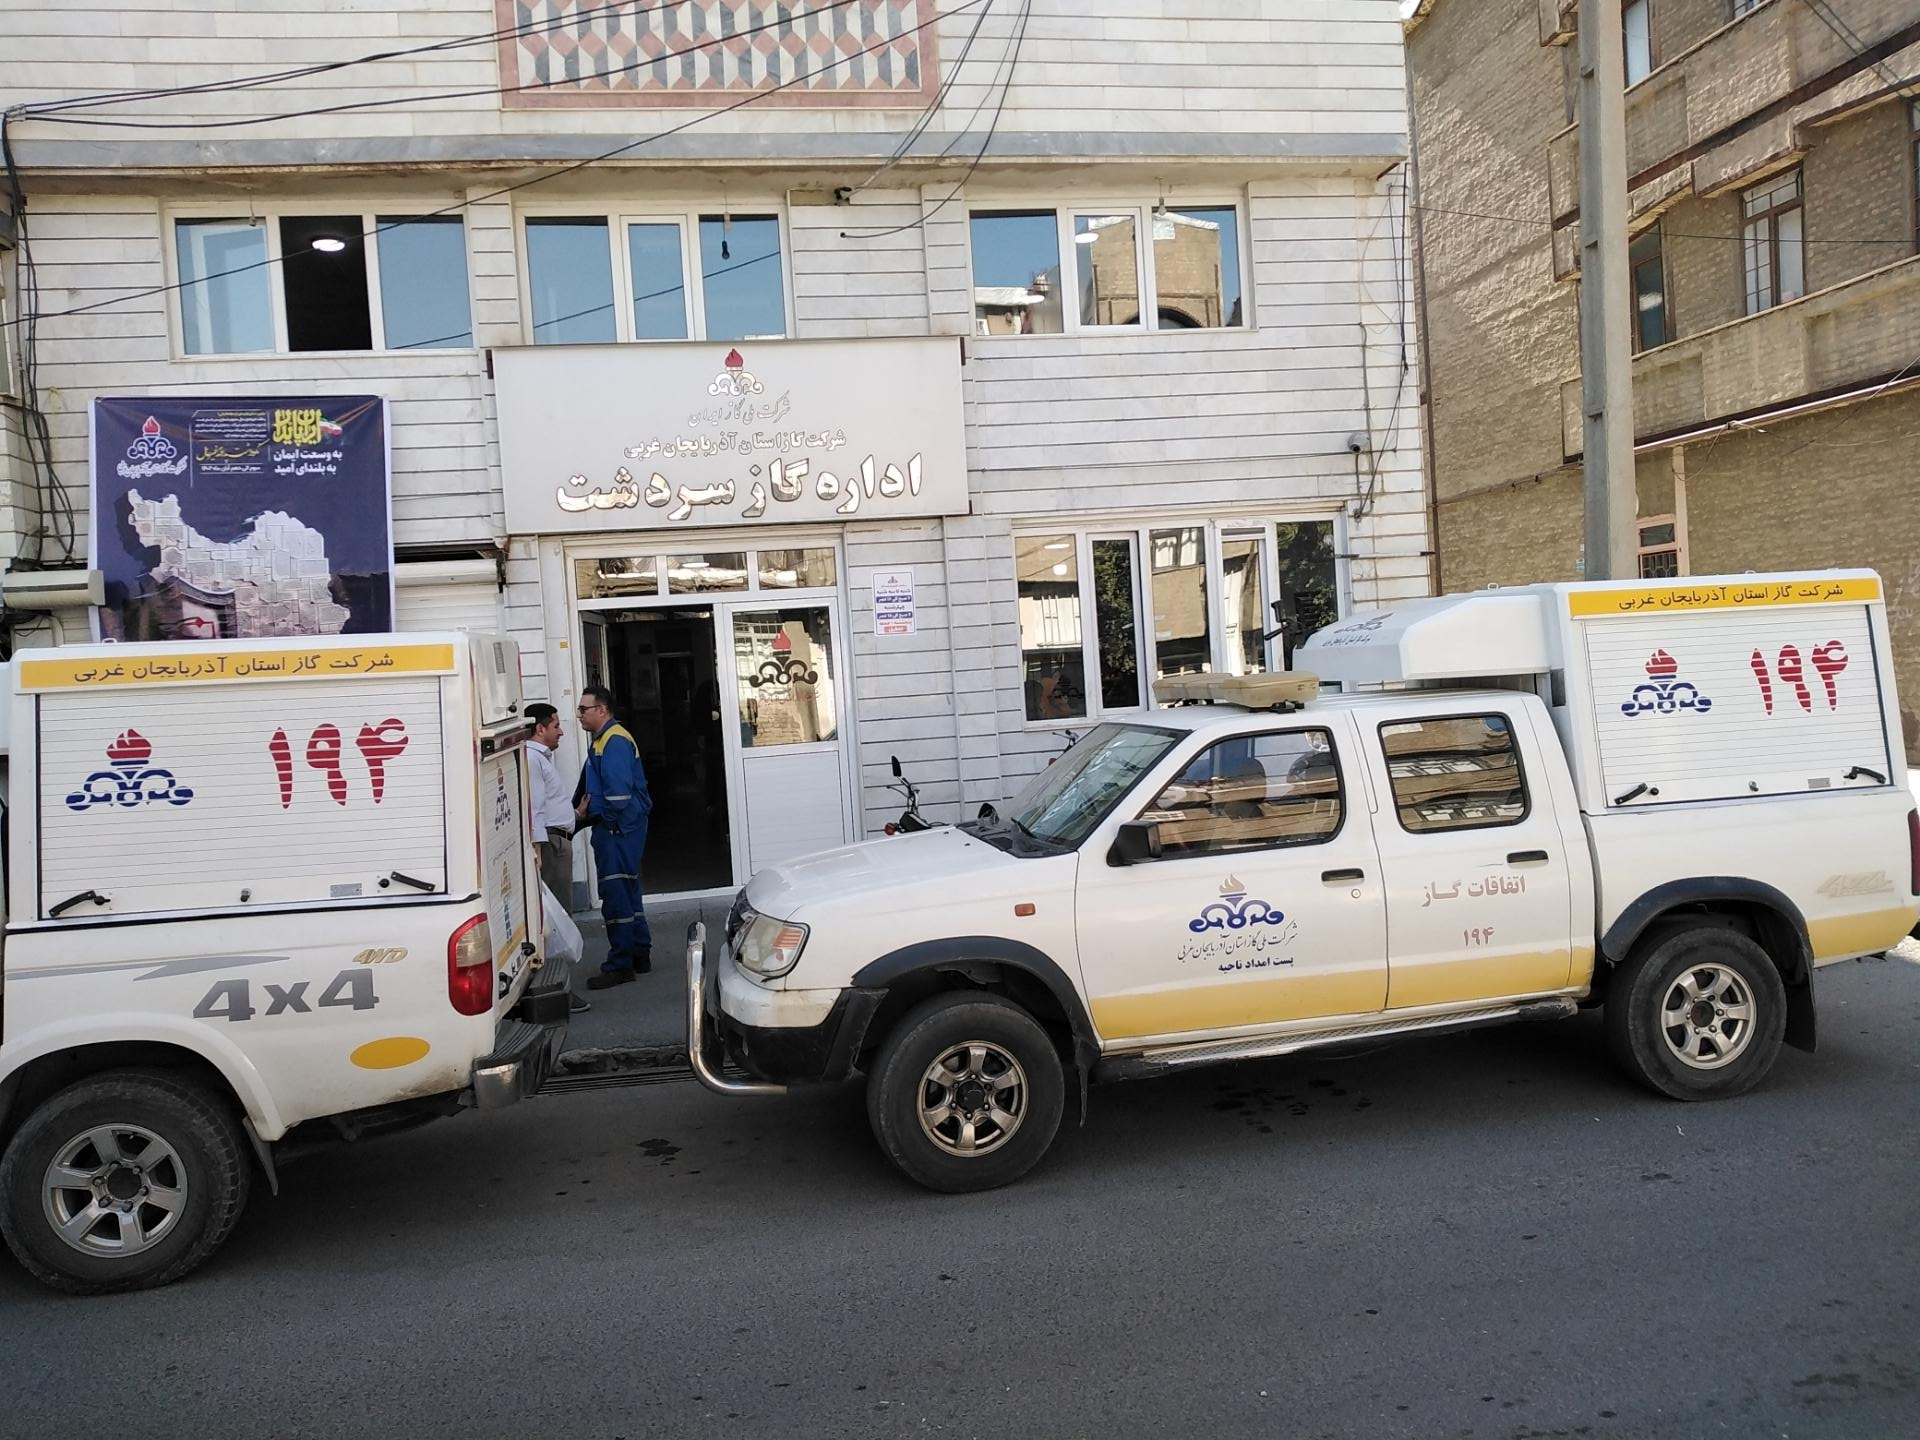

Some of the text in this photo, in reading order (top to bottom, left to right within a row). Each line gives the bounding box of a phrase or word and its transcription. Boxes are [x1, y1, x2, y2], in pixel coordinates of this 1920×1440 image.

[688, 390, 791, 427] شرکت ملی گاز ایران
[624, 437, 661, 461] غربی
[662, 431, 739, 458] آذربایجان
[738, 431, 782, 456] استان
[805, 429, 846, 452] شرکت
[273, 449, 299, 461] ایمان
[300, 450, 331, 461] وسعت
[332, 450, 343, 461] به
[274, 462, 337, 476] به بلندای امید
[556, 452, 922, 521] اداره گاز سردشت
[1619, 584, 1844, 611] شرکت گاز استان آذربایجان غربی
[74, 652, 395, 683] شرکت گاز استان آذربایجان غربی
[1751, 640, 1849, 716] ۱۹۴
[268, 717, 409, 809] ۱۹۴
[1468, 874, 1526, 897] اتفاقات
[1178, 919, 1298, 963] شرکت ملی گاز استان آذربایجان غربی
[1463, 927, 1495, 946] ۱۹۴
[352, 948, 408, 964] 4WD
[1218, 957, 1294, 974] پست امداد ناحیه
[193, 968, 380, 1022] 4x4
